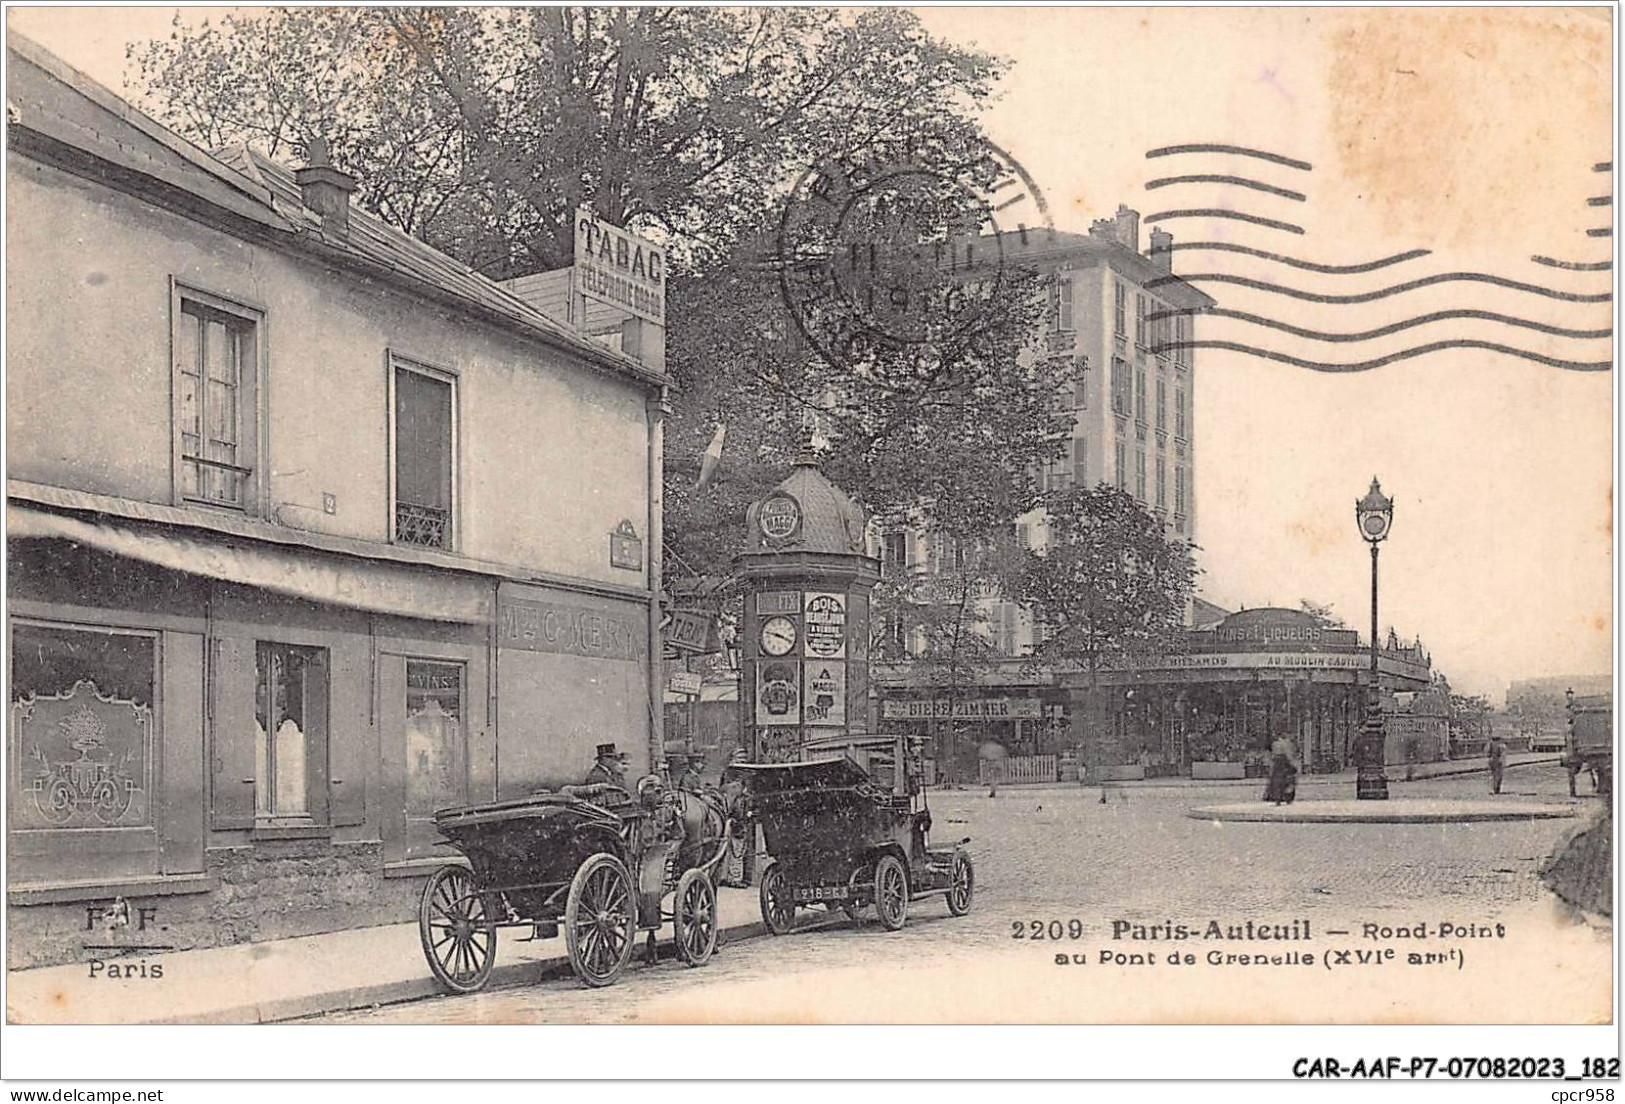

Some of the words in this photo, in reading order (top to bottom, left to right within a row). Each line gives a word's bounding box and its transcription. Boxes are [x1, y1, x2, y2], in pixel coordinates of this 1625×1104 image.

[580, 217, 661, 282] TABAC
[812, 597, 839, 612] BOIS
[1264, 625, 1322, 642] LIQUEURS
[1267, 657, 1281, 666] AU
[1284, 656, 1325, 667] MOULIN
[909, 702, 949, 716] BIERE
